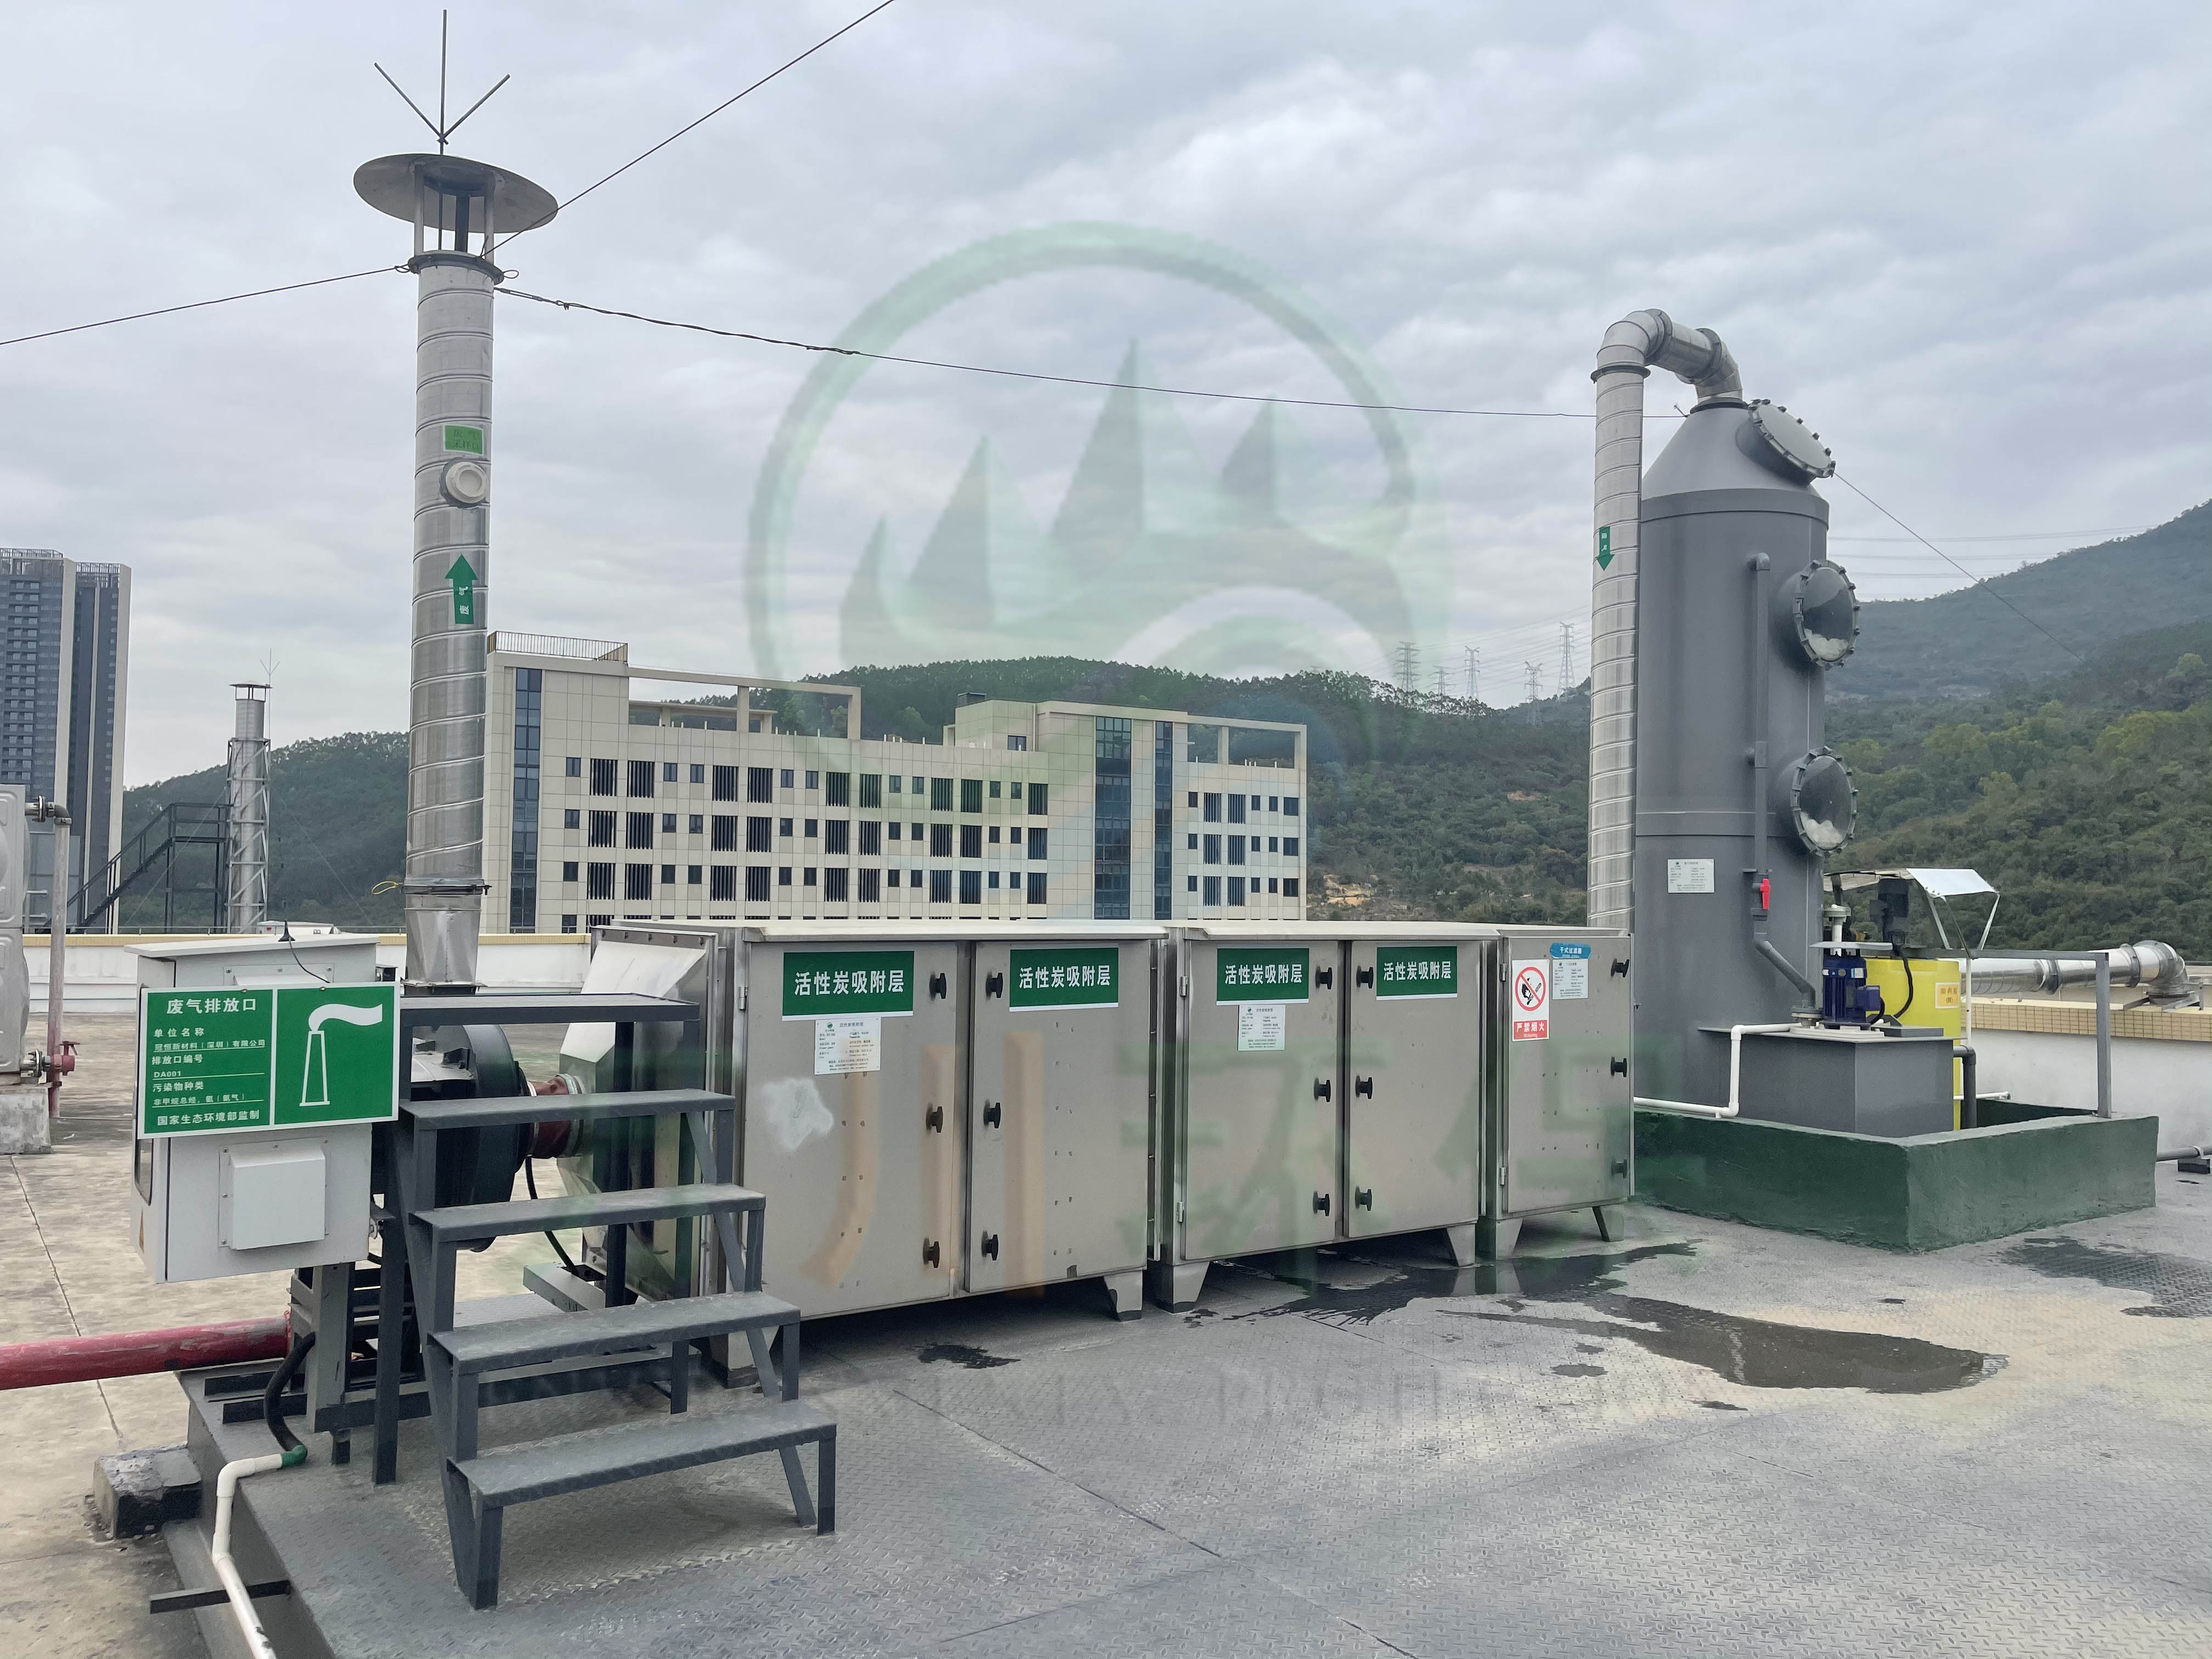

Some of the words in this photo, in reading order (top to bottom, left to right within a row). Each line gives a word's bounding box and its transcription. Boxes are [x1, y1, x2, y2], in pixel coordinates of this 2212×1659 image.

[1018, 964, 1111, 990] 活性炭吸附层
[1224, 962, 1302, 986] 活性炭吸附层
[1383, 961, 1452, 981] 活性炭吸附层
[794, 969, 905, 997] 活性炭吸附层
[166, 997, 257, 1015] 废气排放口
[154, 1027, 205, 1038] 单位名称
[1516, 1022, 1545, 1033] 严禁烟火
[151, 1054, 204, 1065] 排放口编号
[153, 1081, 205, 1092] 污染物种类
[157, 1109, 259, 1126] 国家生态环境部监制
